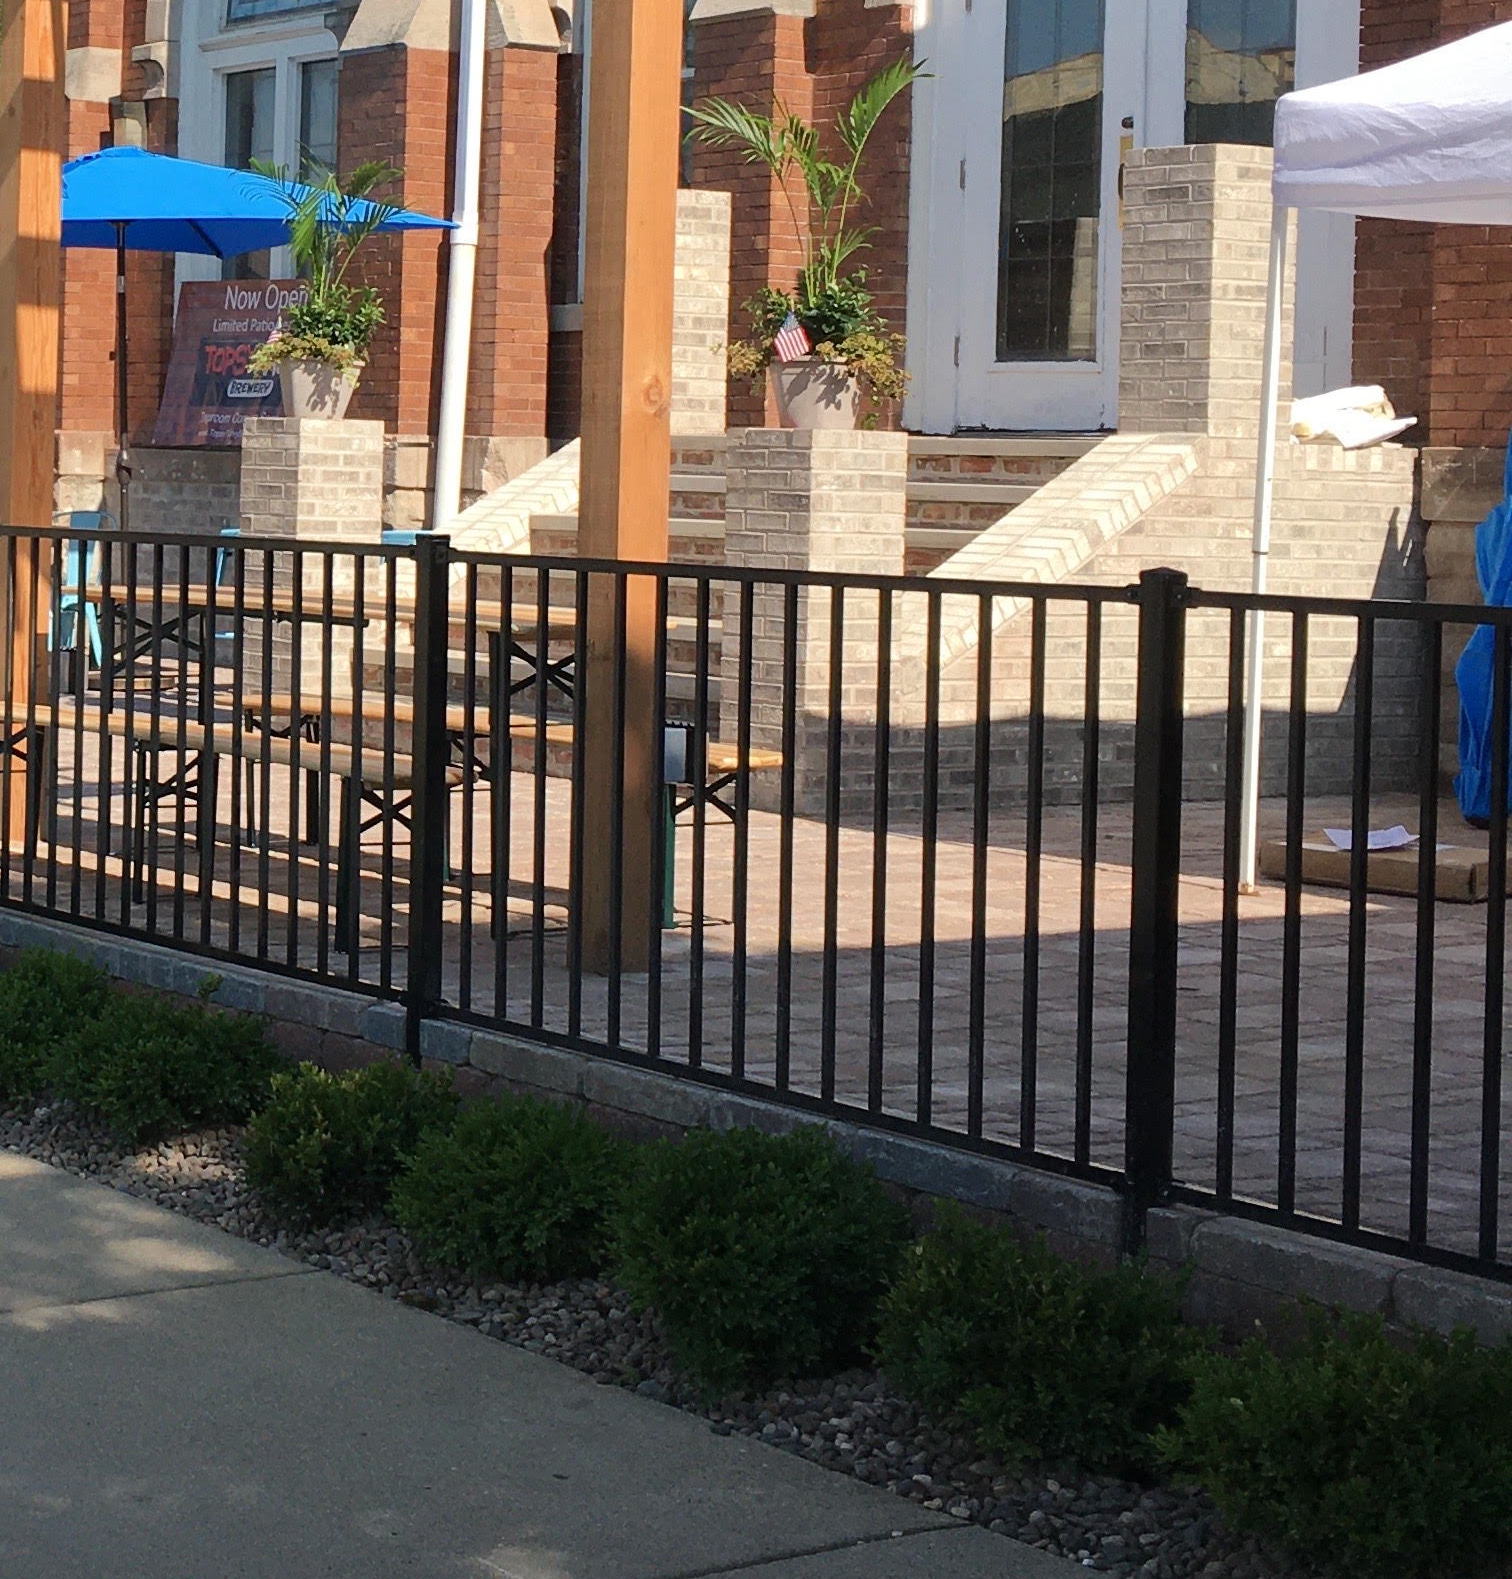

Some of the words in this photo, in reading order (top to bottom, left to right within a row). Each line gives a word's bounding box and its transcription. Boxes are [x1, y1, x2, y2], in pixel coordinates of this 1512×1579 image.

[224, 285, 262, 310] Now
[265, 283, 309, 312] Open
[213, 318, 249, 332] Limited
[250, 318, 274, 332] Patio
[205, 345, 251, 376] TOPS
[230, 380, 272, 395] BREWERY
